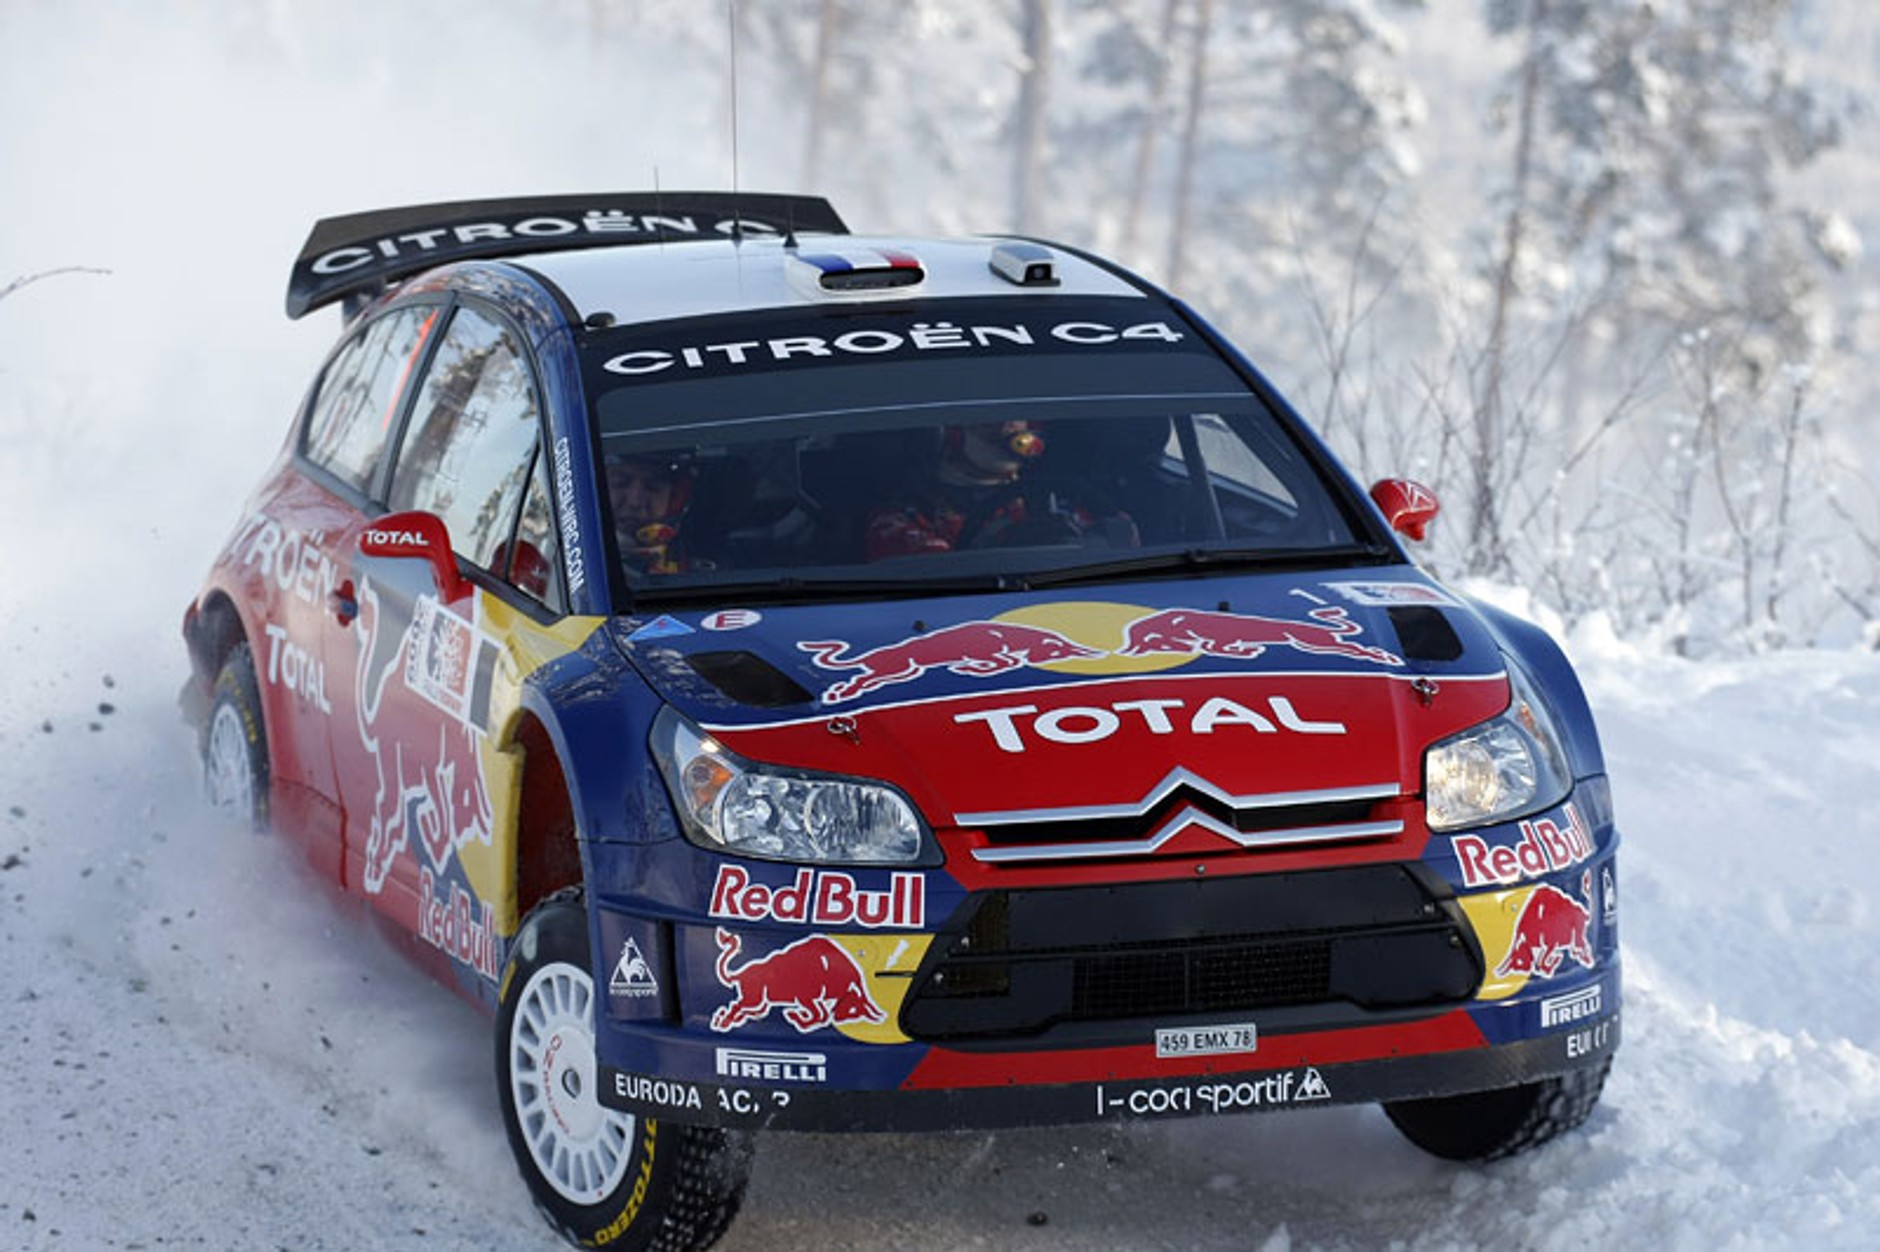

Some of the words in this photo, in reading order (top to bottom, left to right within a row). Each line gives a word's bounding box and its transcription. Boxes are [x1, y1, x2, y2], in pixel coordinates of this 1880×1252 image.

[311, 209, 697, 275] CITROËN
[602, 321, 1035, 375] CITROËN
[1050, 321, 1184, 344] C4
[365, 528, 430, 547] TOTAL
[264, 622, 332, 716] TOTAL
[953, 695, 1348, 753] TOTAL
[1451, 820, 1549, 887] Red
[1532, 802, 1599, 871] Bull
[419, 864, 458, 958] Red
[455, 888, 499, 982] Bull
[708, 864, 814, 924] Red
[811, 871, 925, 928] Bull
[1541, 984, 1601, 1028] PIRELLI
[715, 1047, 827, 1081] PIRELLI
[1161, 1033, 1188, 1051] 459
[1193, 1031, 1228, 1049] EMX
[1196, 1071, 1293, 1112] sportif
